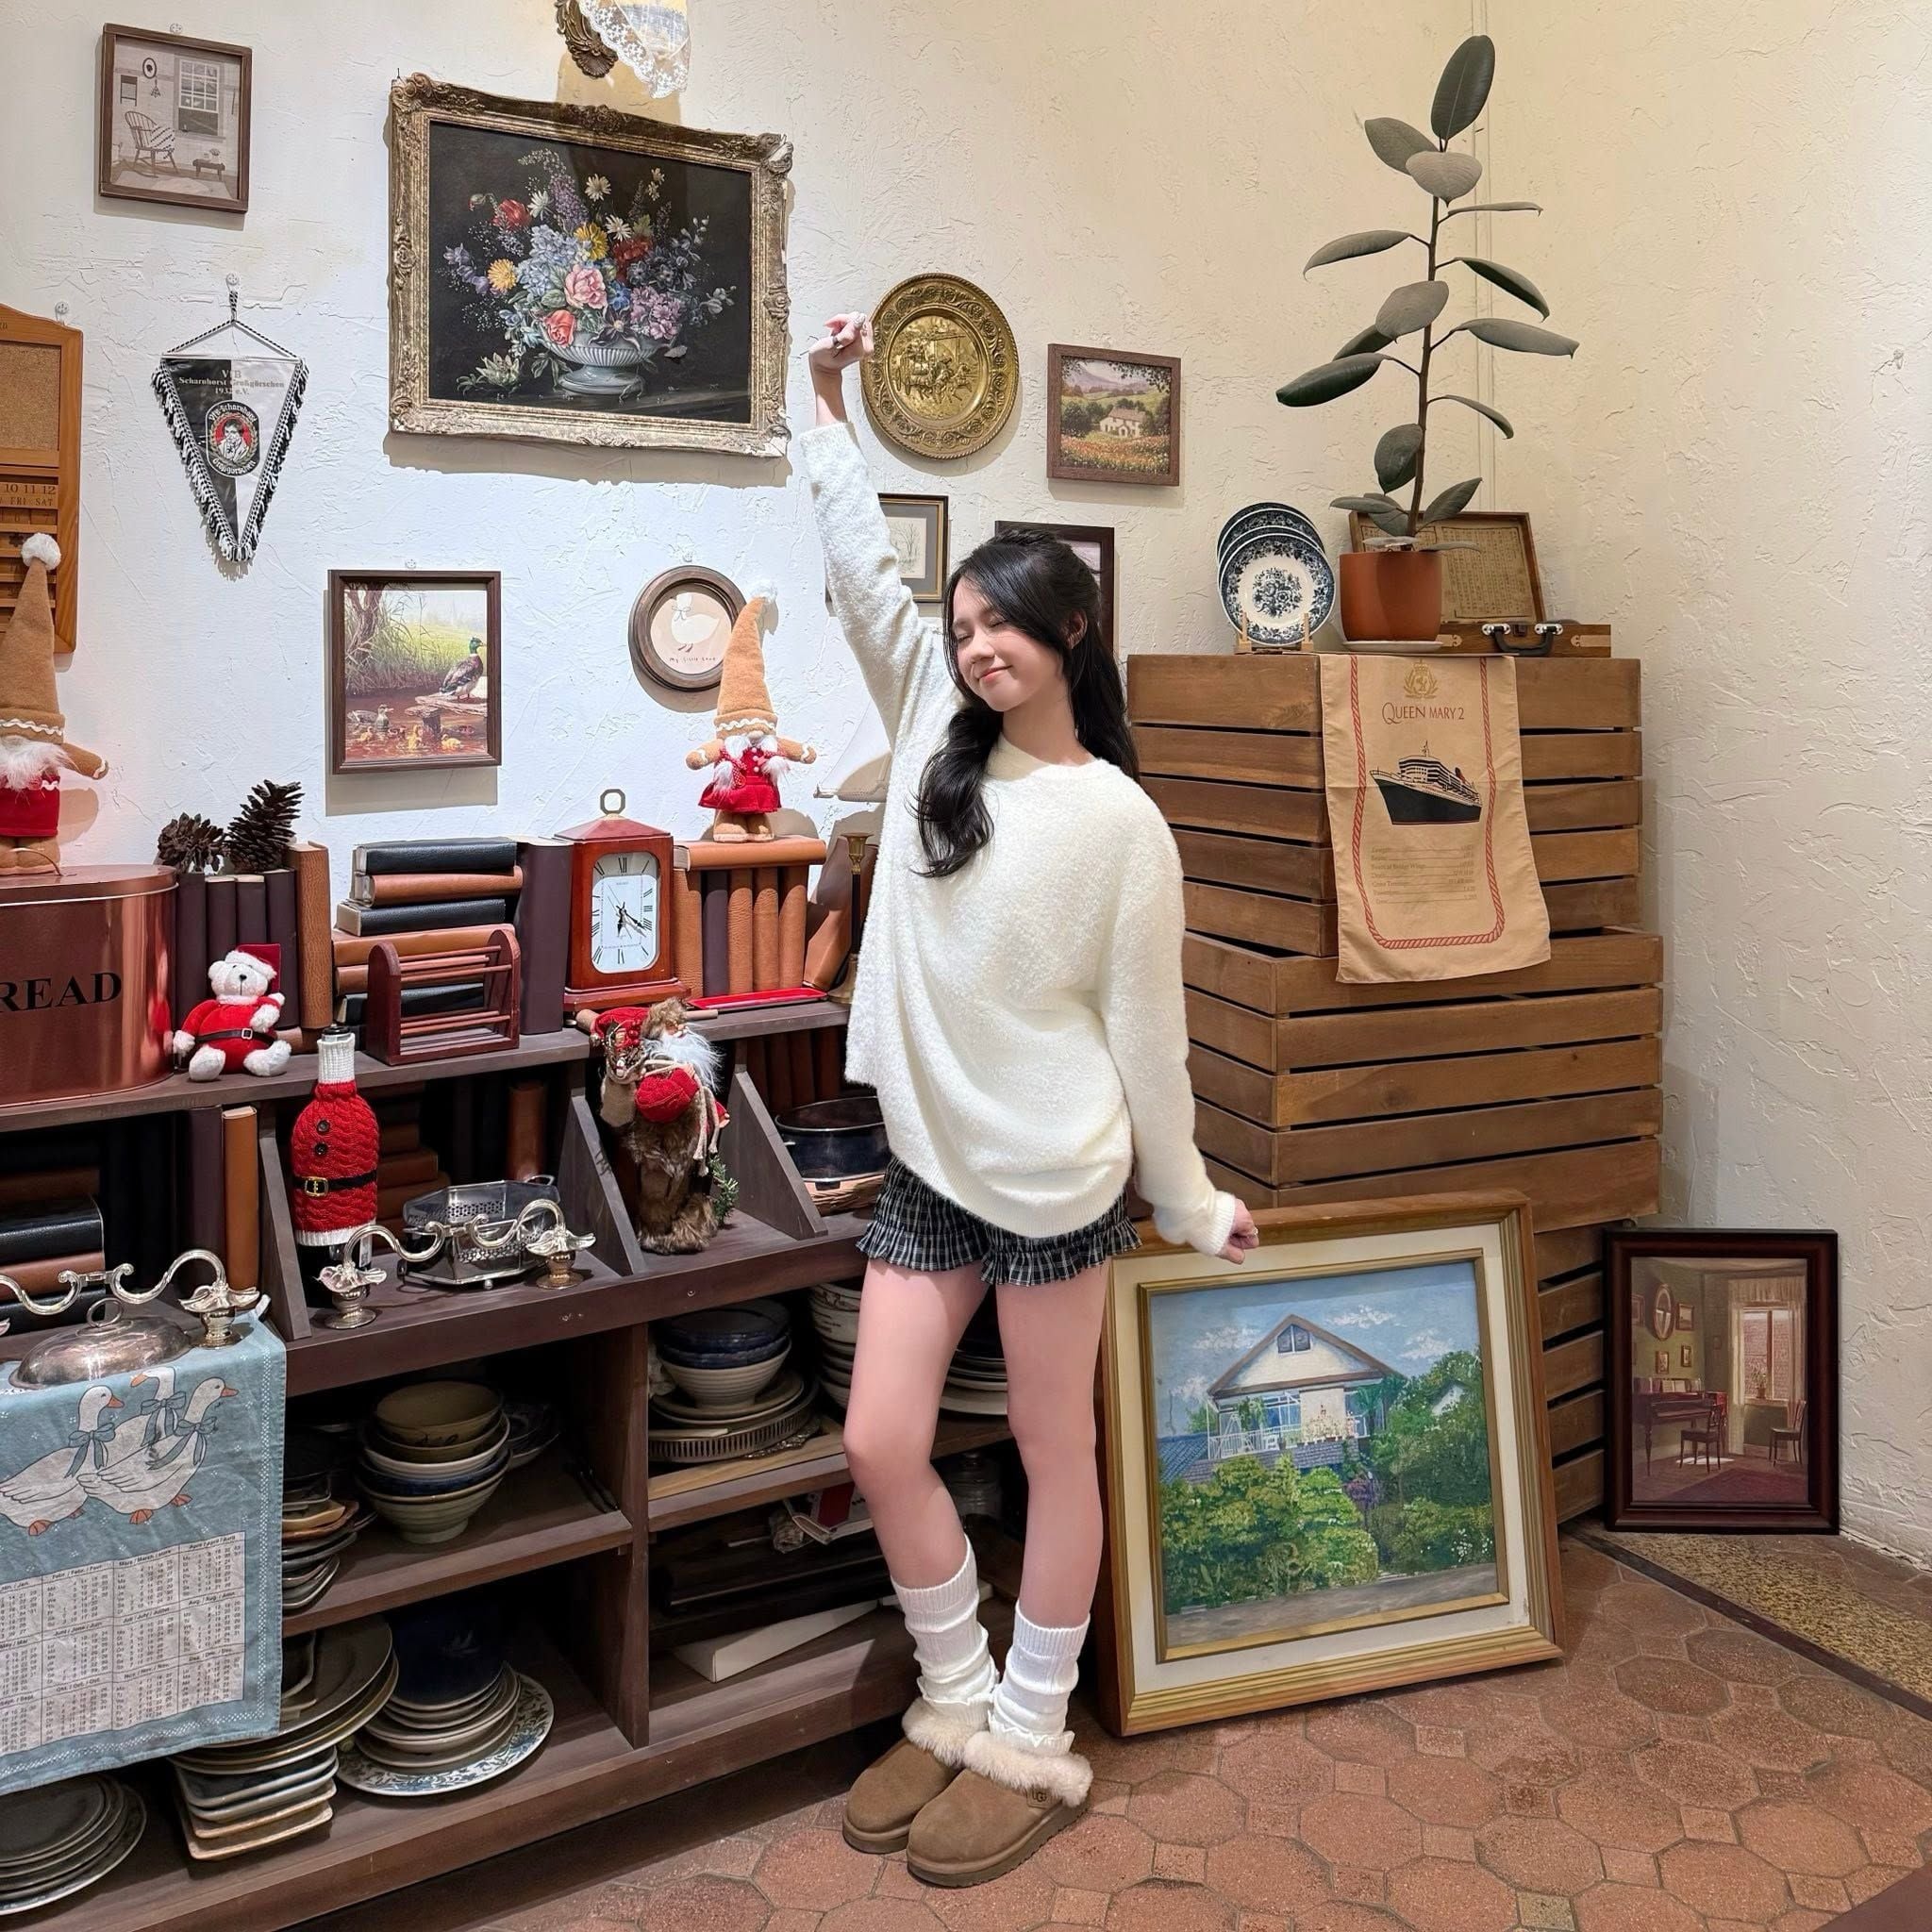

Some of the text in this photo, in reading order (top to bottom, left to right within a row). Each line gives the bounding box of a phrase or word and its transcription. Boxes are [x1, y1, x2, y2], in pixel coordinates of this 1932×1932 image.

[6, 483, 57, 494] 10 11 12
[35, 497, 54, 507] SAT
[1382, 702, 1465, 724] QUEEN MARY 2
[0, 972, 122, 1012] READ
